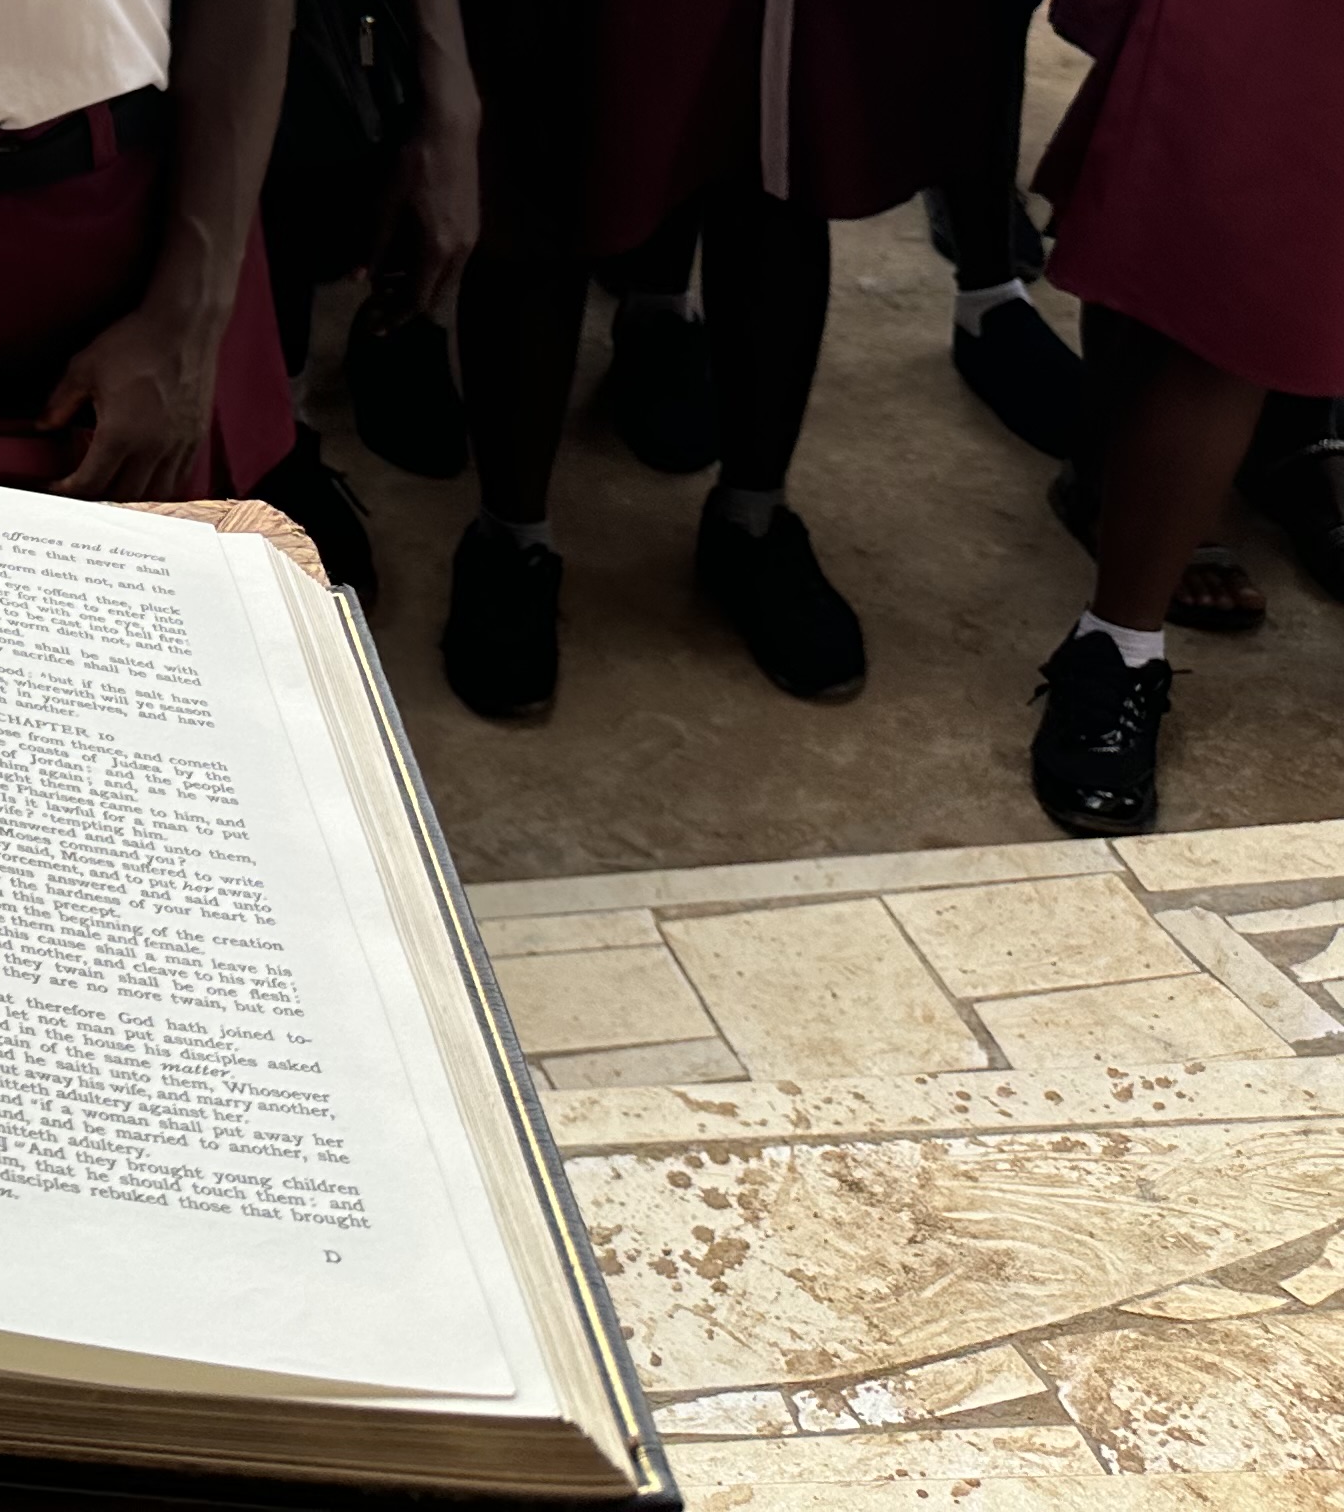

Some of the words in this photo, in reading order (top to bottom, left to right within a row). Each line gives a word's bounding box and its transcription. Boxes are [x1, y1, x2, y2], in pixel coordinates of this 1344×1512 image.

[2, 532, 63, 546] offences
[71, 543, 101, 551] and
[109, 547, 165, 562] divorce
[16, 698, 78, 717] another.
[98, 733, 115, 742] 10
[5, 1006, 30, 1021] let
[37, 1015, 68, 1028] not
[76, 1022, 115, 1035] man
[124, 1030, 154, 1041] put
[163, 1035, 239, 1052] asunder.
[40, 1042, 58, 1054] of
[65, 1046, 95, 1060] the
[104, 1054, 151, 1069] same
[160, 1063, 235, 1079] matter.
[56, 1089, 132, 1112] adultery
[138, 1103, 208, 1119] against
[212, 1108, 249, 1124] her.
[68, 1136, 150, 1159] adultery.
[0, 1169, 81, 1194] disciples
[90, 1186, 169, 1206] rebuked
[178, 1196, 232, 1214] those
[241, 1203, 282, 1220] that
[290, 1208, 371, 1229] brought
[323, 1250, 342, 1264] D
